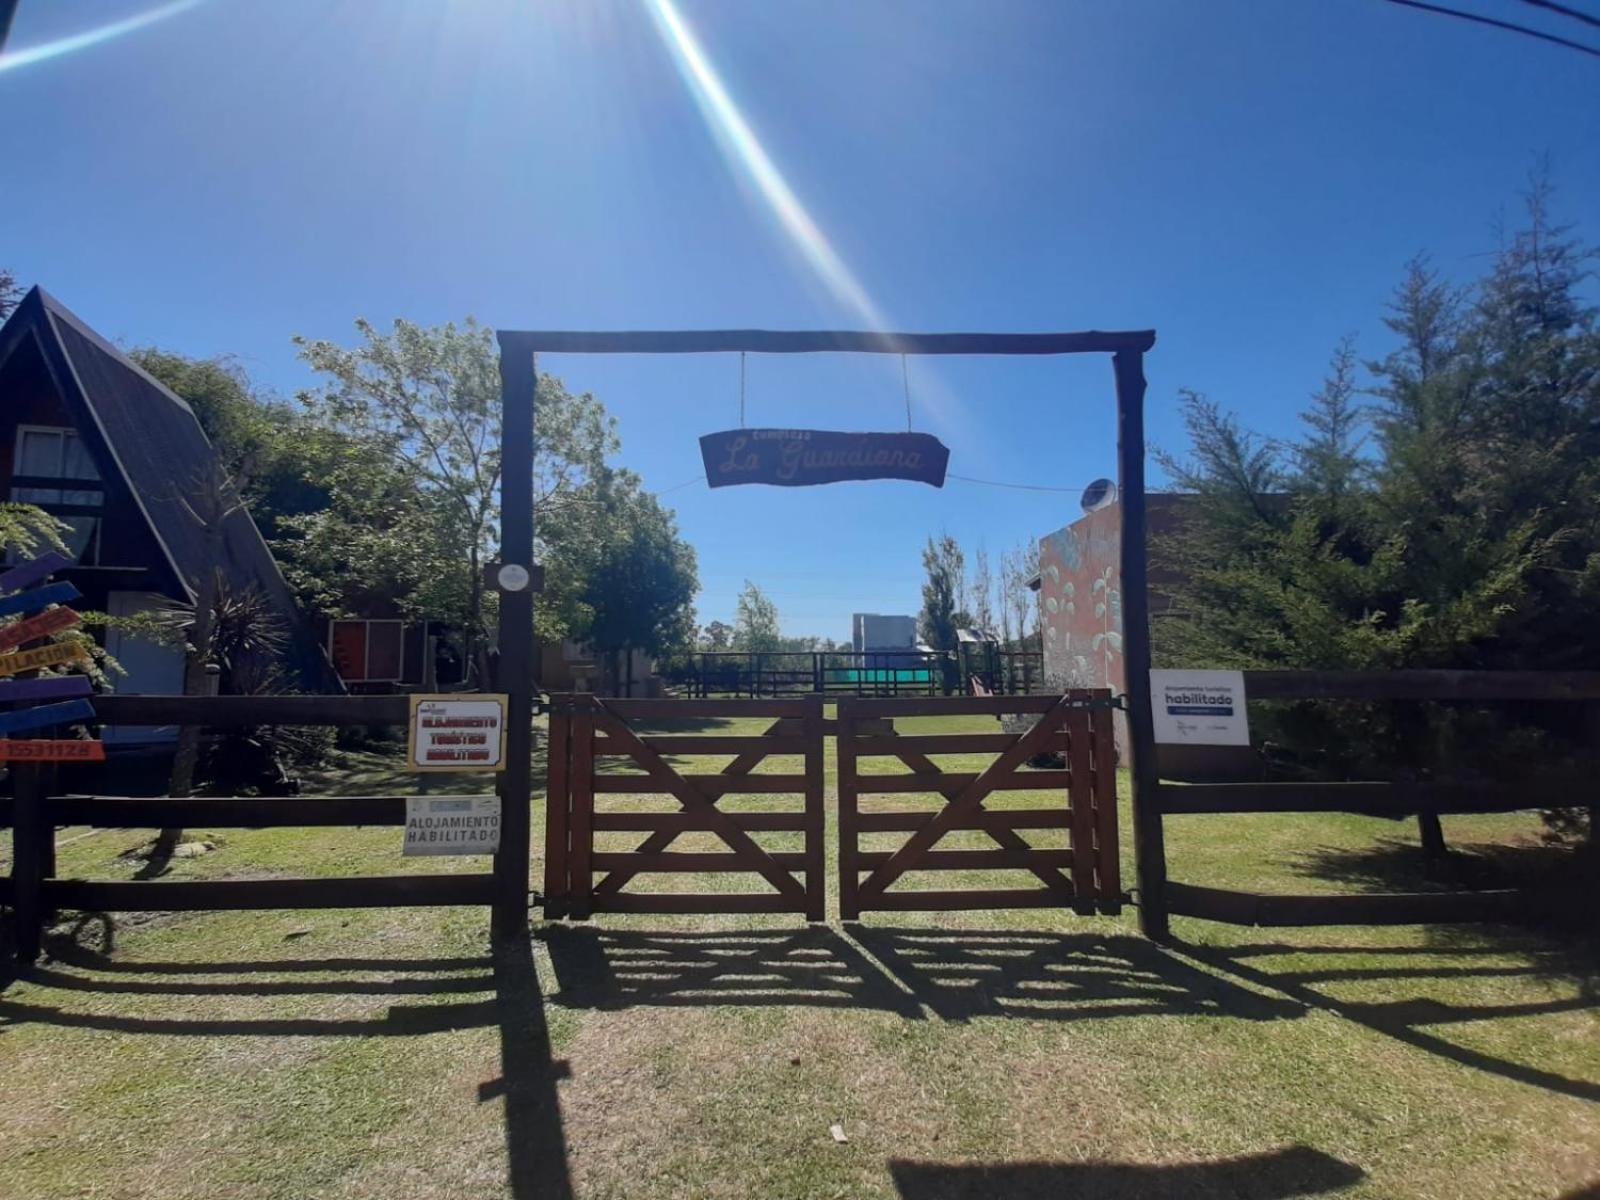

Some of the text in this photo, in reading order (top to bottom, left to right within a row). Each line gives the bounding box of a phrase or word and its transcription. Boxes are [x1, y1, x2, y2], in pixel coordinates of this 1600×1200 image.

[719, 435, 922, 479] La Guardiana
[1165, 693, 1233, 705] habilitado
[422, 716, 498, 728] ALOJAMIENTO
[409, 816, 498, 829] ALOJAMIENTO
[408, 830, 498, 843] HABILITADO
